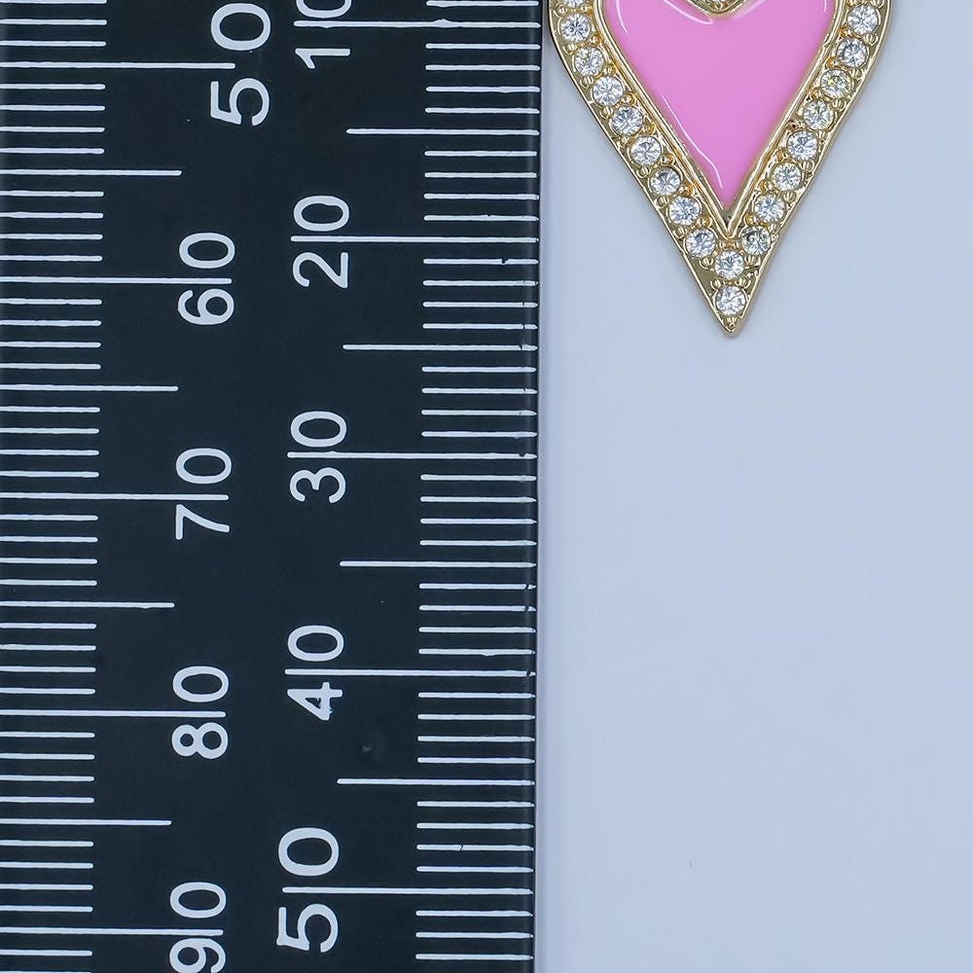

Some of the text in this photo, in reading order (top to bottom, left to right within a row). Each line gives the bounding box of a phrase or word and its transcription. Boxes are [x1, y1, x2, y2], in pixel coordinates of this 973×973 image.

[211, 3, 270, 125] 50
[178, 233, 235, 325] 60
[293, 196, 349, 288] 20
[176, 448, 231, 540] 70
[290, 411, 346, 503] 30
[172, 666, 229, 759] 80
[287, 625, 344, 720] 40
[170, 882, 226, 973] 90
[276, 828, 339, 952] 50
